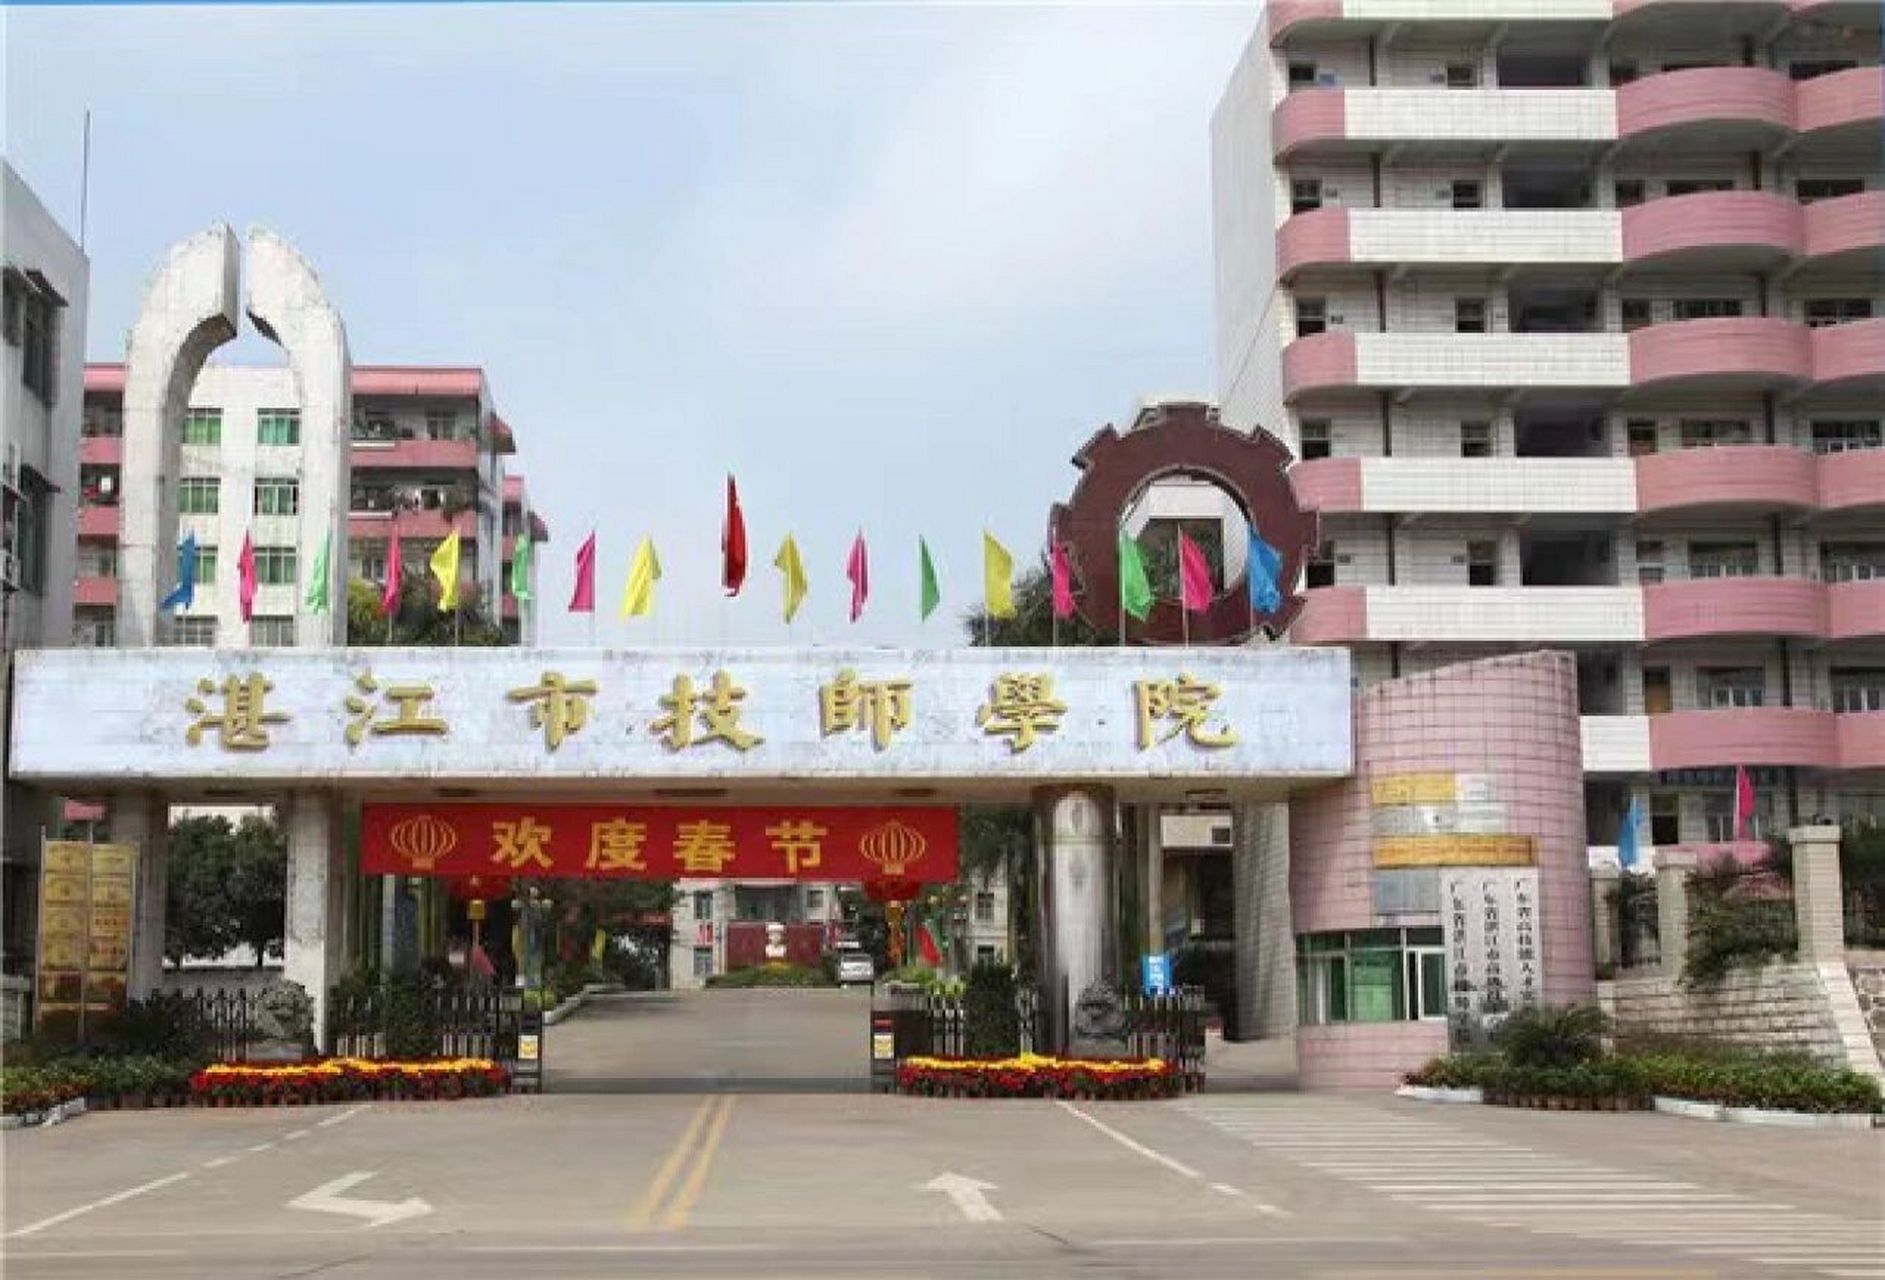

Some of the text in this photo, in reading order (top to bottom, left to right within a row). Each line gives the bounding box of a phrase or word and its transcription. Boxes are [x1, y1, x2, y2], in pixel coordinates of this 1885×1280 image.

[185, 669, 1239, 751] 湛江市技師學院
[491, 815, 828, 873] 欢度春节
